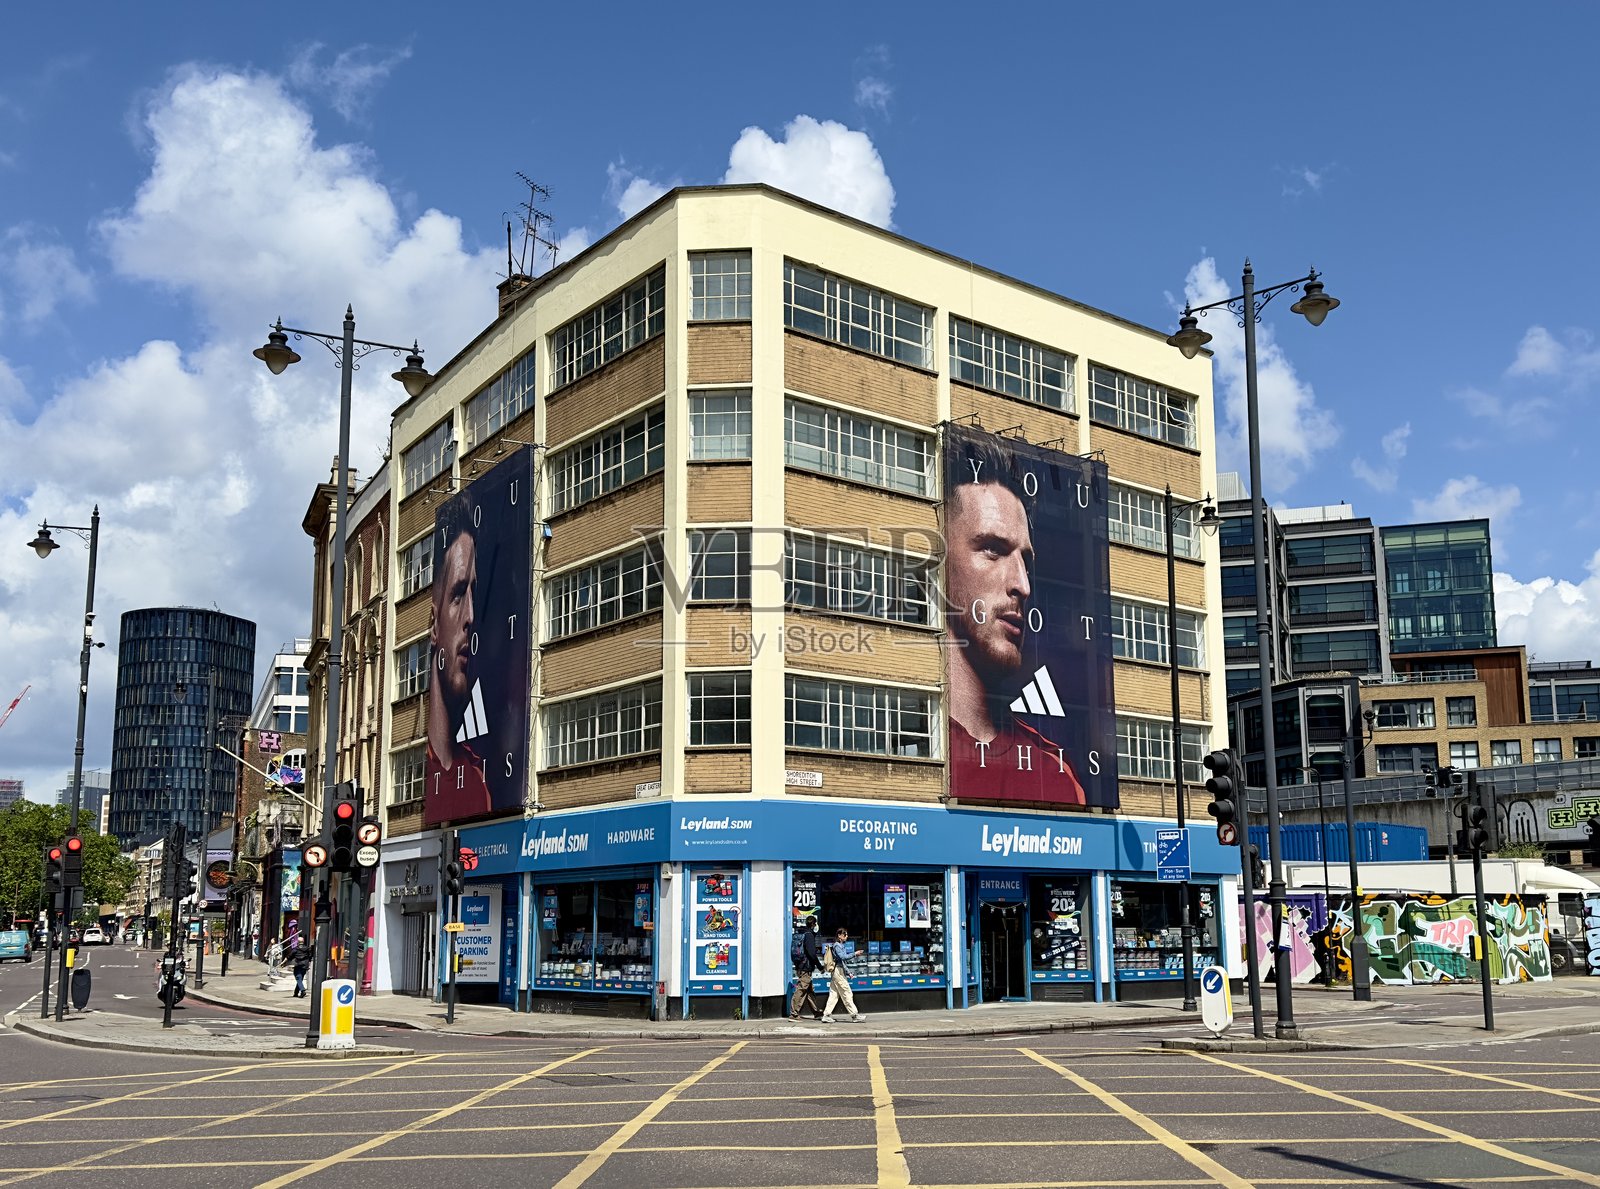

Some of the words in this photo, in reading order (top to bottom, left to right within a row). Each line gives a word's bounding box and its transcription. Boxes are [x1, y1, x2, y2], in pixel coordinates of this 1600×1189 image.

[966, 458, 1091, 508] YOU
[441, 479, 519, 549] YOU
[971, 598, 1096, 641] GOT
[437, 614, 518, 671] GOT
[974, 741, 1100, 776] THIS
[433, 752, 513, 795] THIS
[786, 771, 817, 779] SHOREDITCH
[607, 827, 655, 845] HARDWARE
[840, 819, 918, 836] DECORATING
[478, 843, 509, 858] ELECTRICAL
[863, 836, 872, 850] &
[875, 837, 896, 851] DIY
[359, 849, 377, 857] Except
[980, 880, 1020, 890] ENTRANCE
[456, 936, 492, 945] CUSTOMER
[1430, 921, 1473, 945] TRP
[460, 947, 489, 956] PARKING
